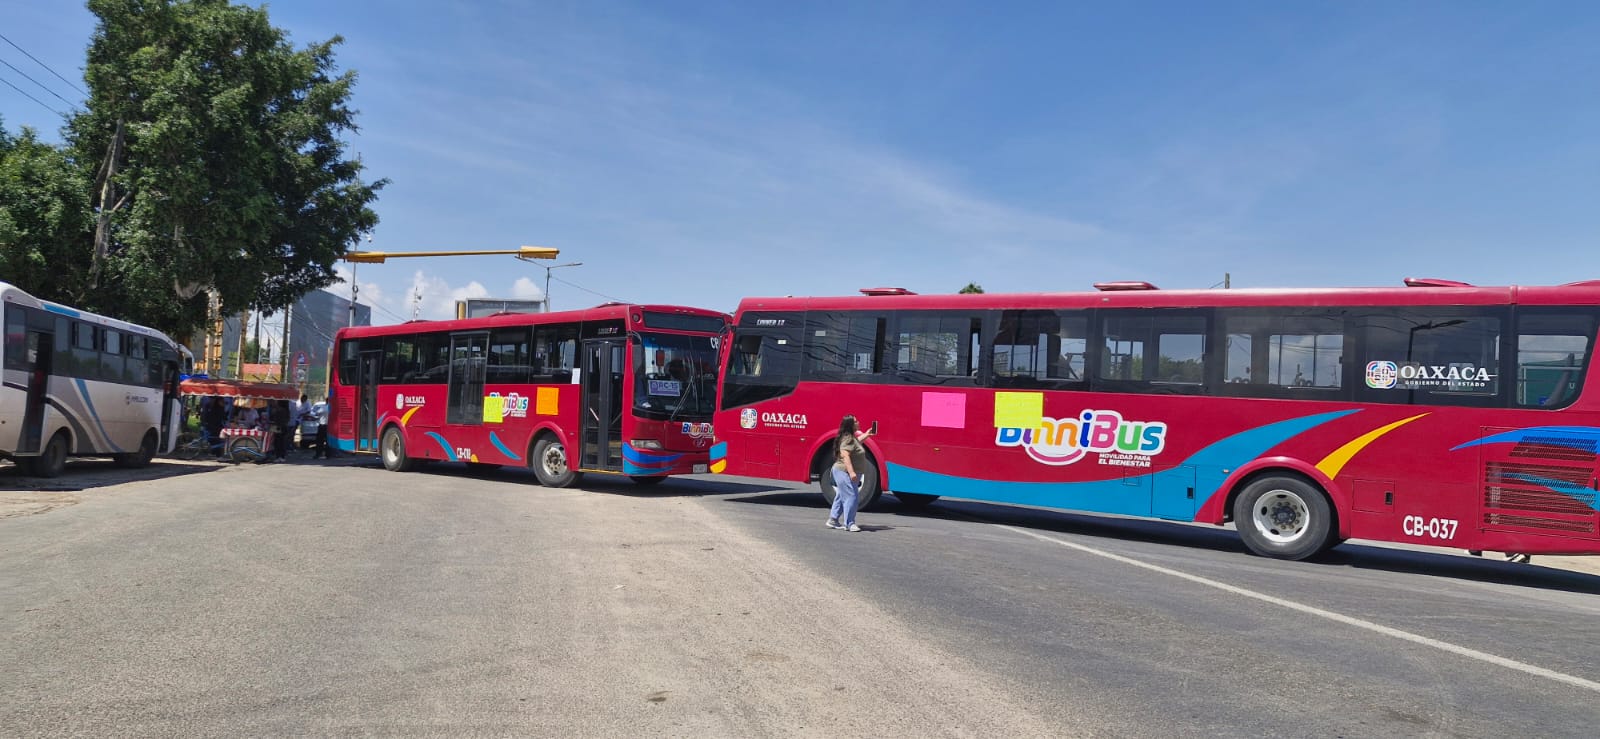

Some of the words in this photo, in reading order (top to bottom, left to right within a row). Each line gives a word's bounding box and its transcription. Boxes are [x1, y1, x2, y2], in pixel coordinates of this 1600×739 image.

[1400, 365, 1490, 381] OAXACA
[761, 412, 808, 425] OAXACA
[682, 422, 714, 434] BinniBu
[1108, 459, 1151, 468] BIENESTAR
[1403, 515, 1458, 540] CB-037
